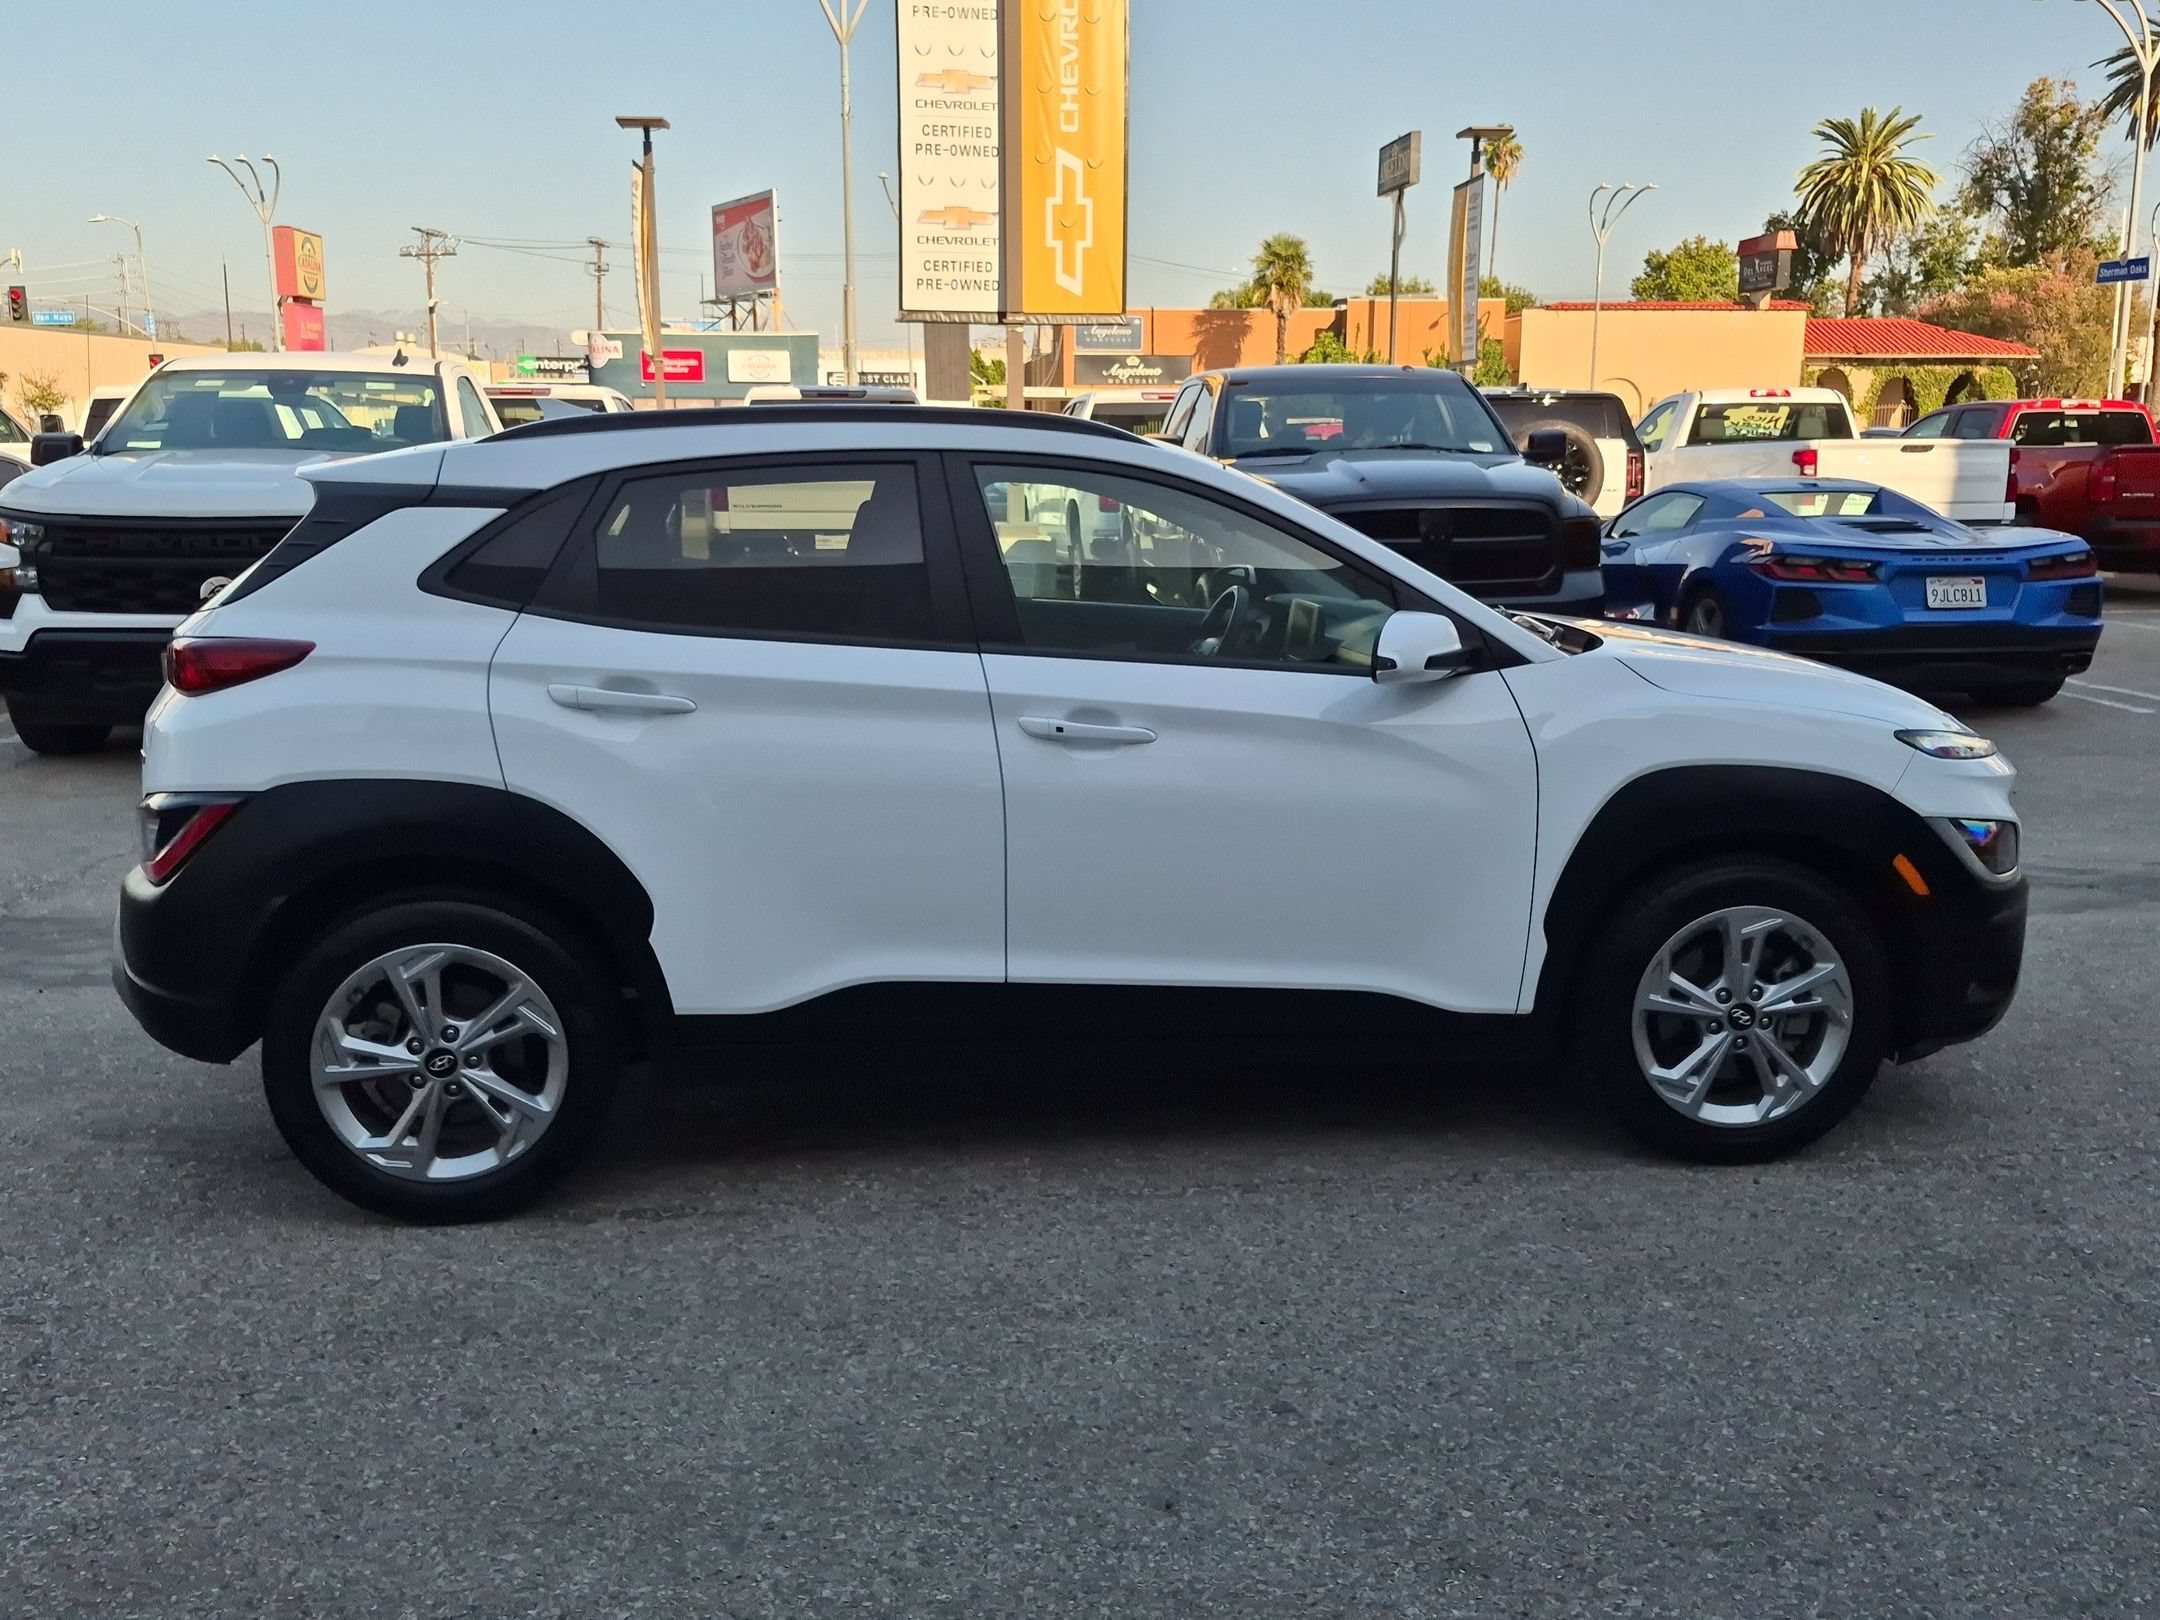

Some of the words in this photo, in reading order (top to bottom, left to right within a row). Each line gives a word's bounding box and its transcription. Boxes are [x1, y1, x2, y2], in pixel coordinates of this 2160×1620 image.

[912, 5, 999, 20] PRE-OWNED
[915, 98, 999, 111] CHEVROLET
[921, 124, 993, 139] CERTIFIED
[915, 143, 1000, 158] PRE-OWNED
[916, 235, 1000, 247] CHEVROLET
[923, 259, 993, 273] CERTIFIED
[2099, 266, 2128, 278] Sherman
[2130, 264, 2147, 275] Oaks
[916, 278, 1001, 291] PRE-OWNED
[35, 313, 50, 321] Van
[53, 313, 72, 322] Nuys
[1102, 363, 1163, 380] Angeleno
[1931, 588, 1982, 603] 9JLC811
